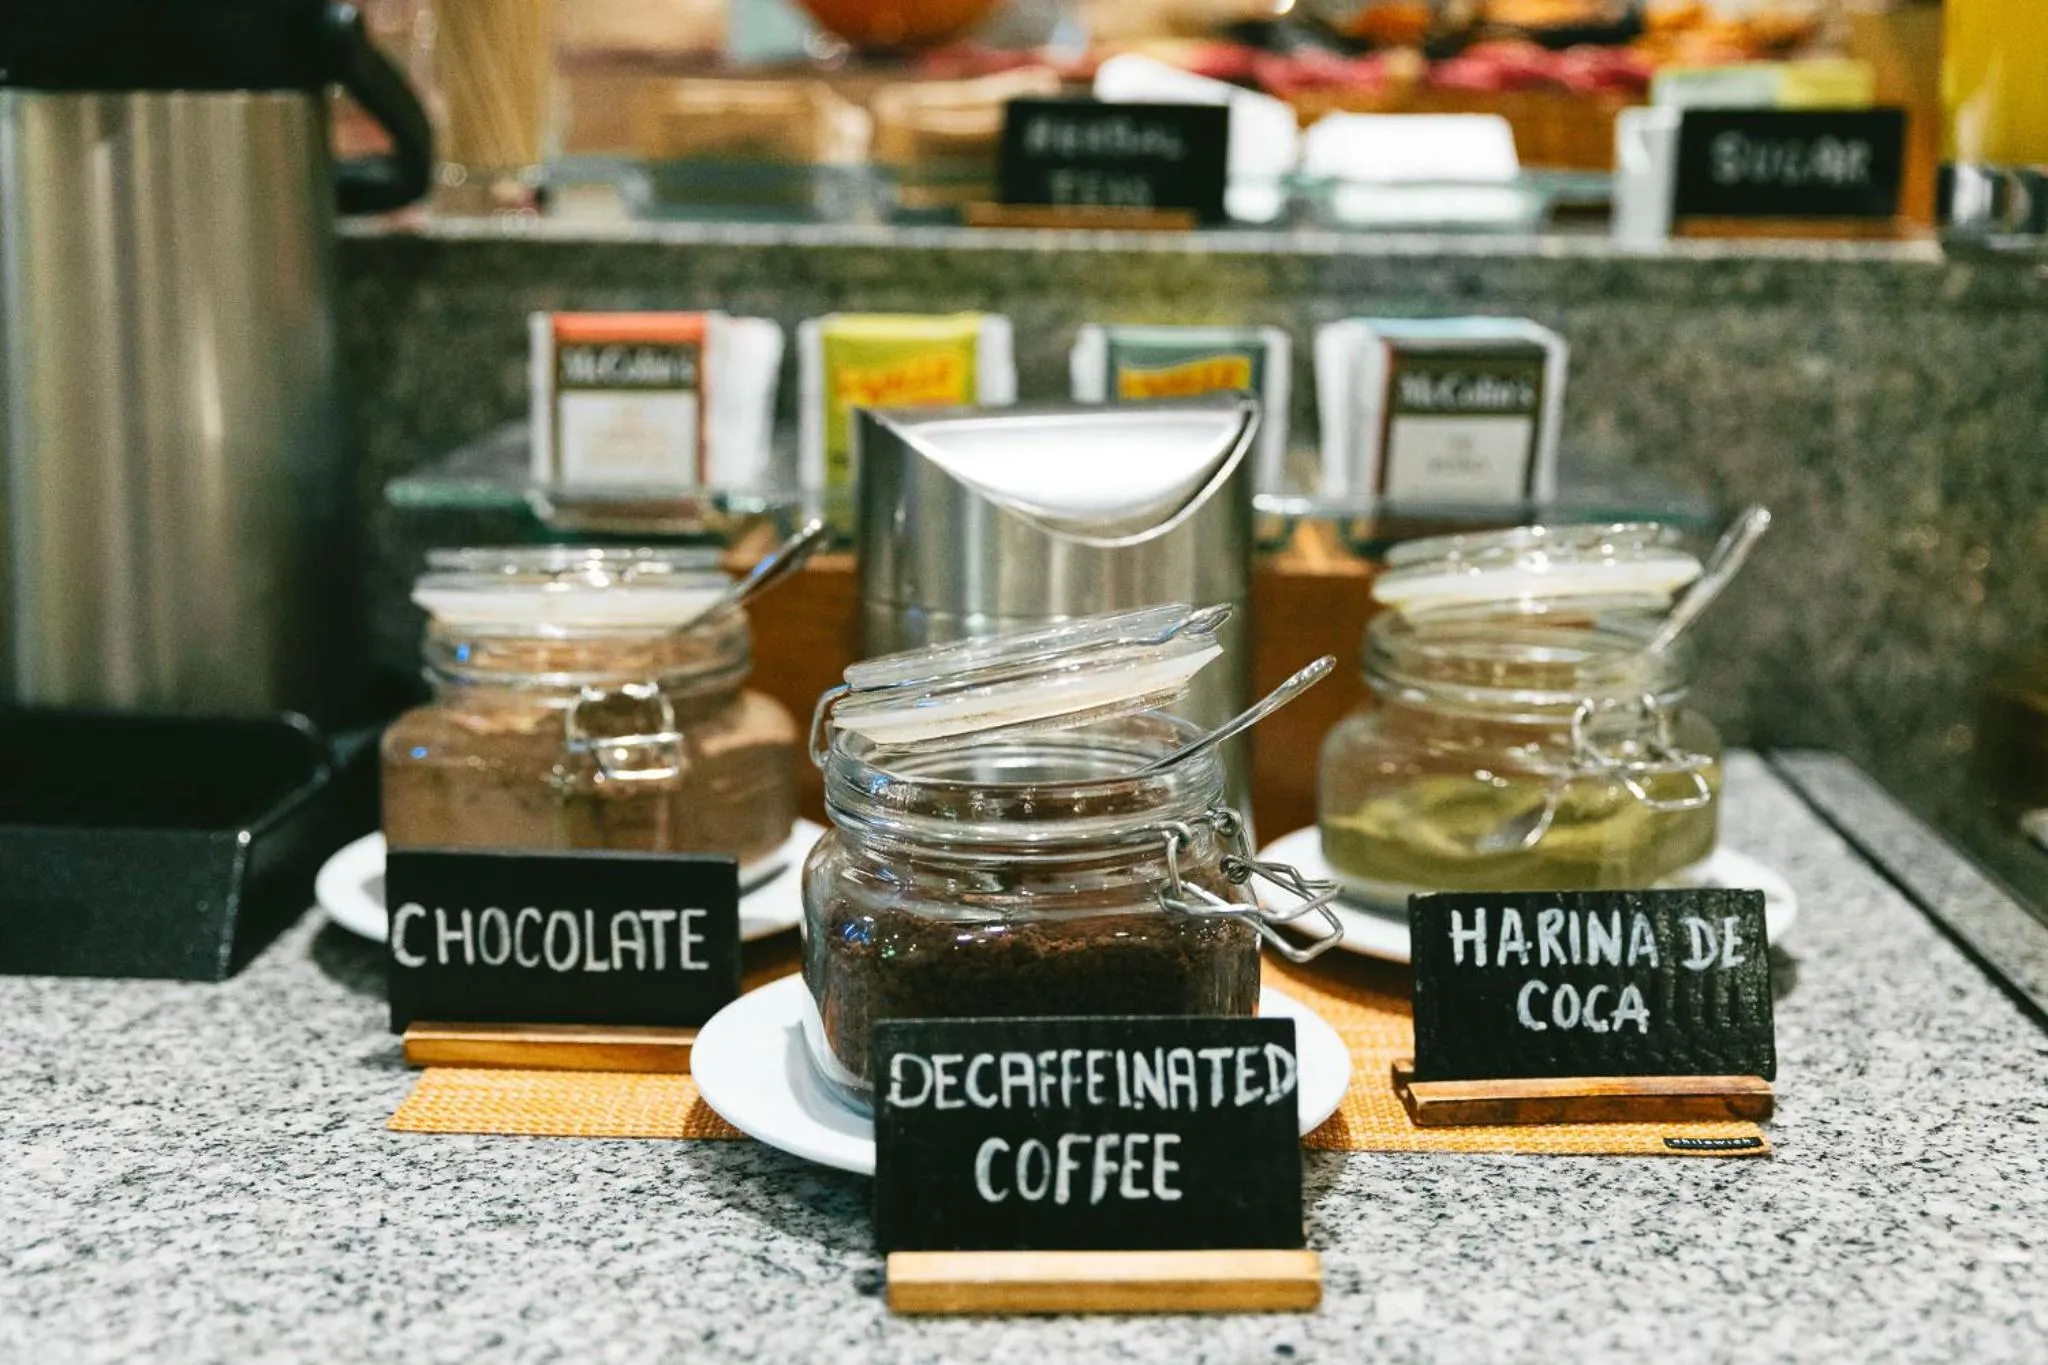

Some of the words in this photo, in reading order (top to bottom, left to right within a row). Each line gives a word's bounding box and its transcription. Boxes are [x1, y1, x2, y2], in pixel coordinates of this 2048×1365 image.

[391, 902, 709, 972] CHOCOLATE
[1450, 907, 1659, 967] HARINA
[1681, 915, 1746, 970] DE
[1516, 979, 1650, 1034] COCA
[886, 1042, 1297, 1112] DECAFFEINATED
[974, 1133, 1183, 1205] COFFEE
